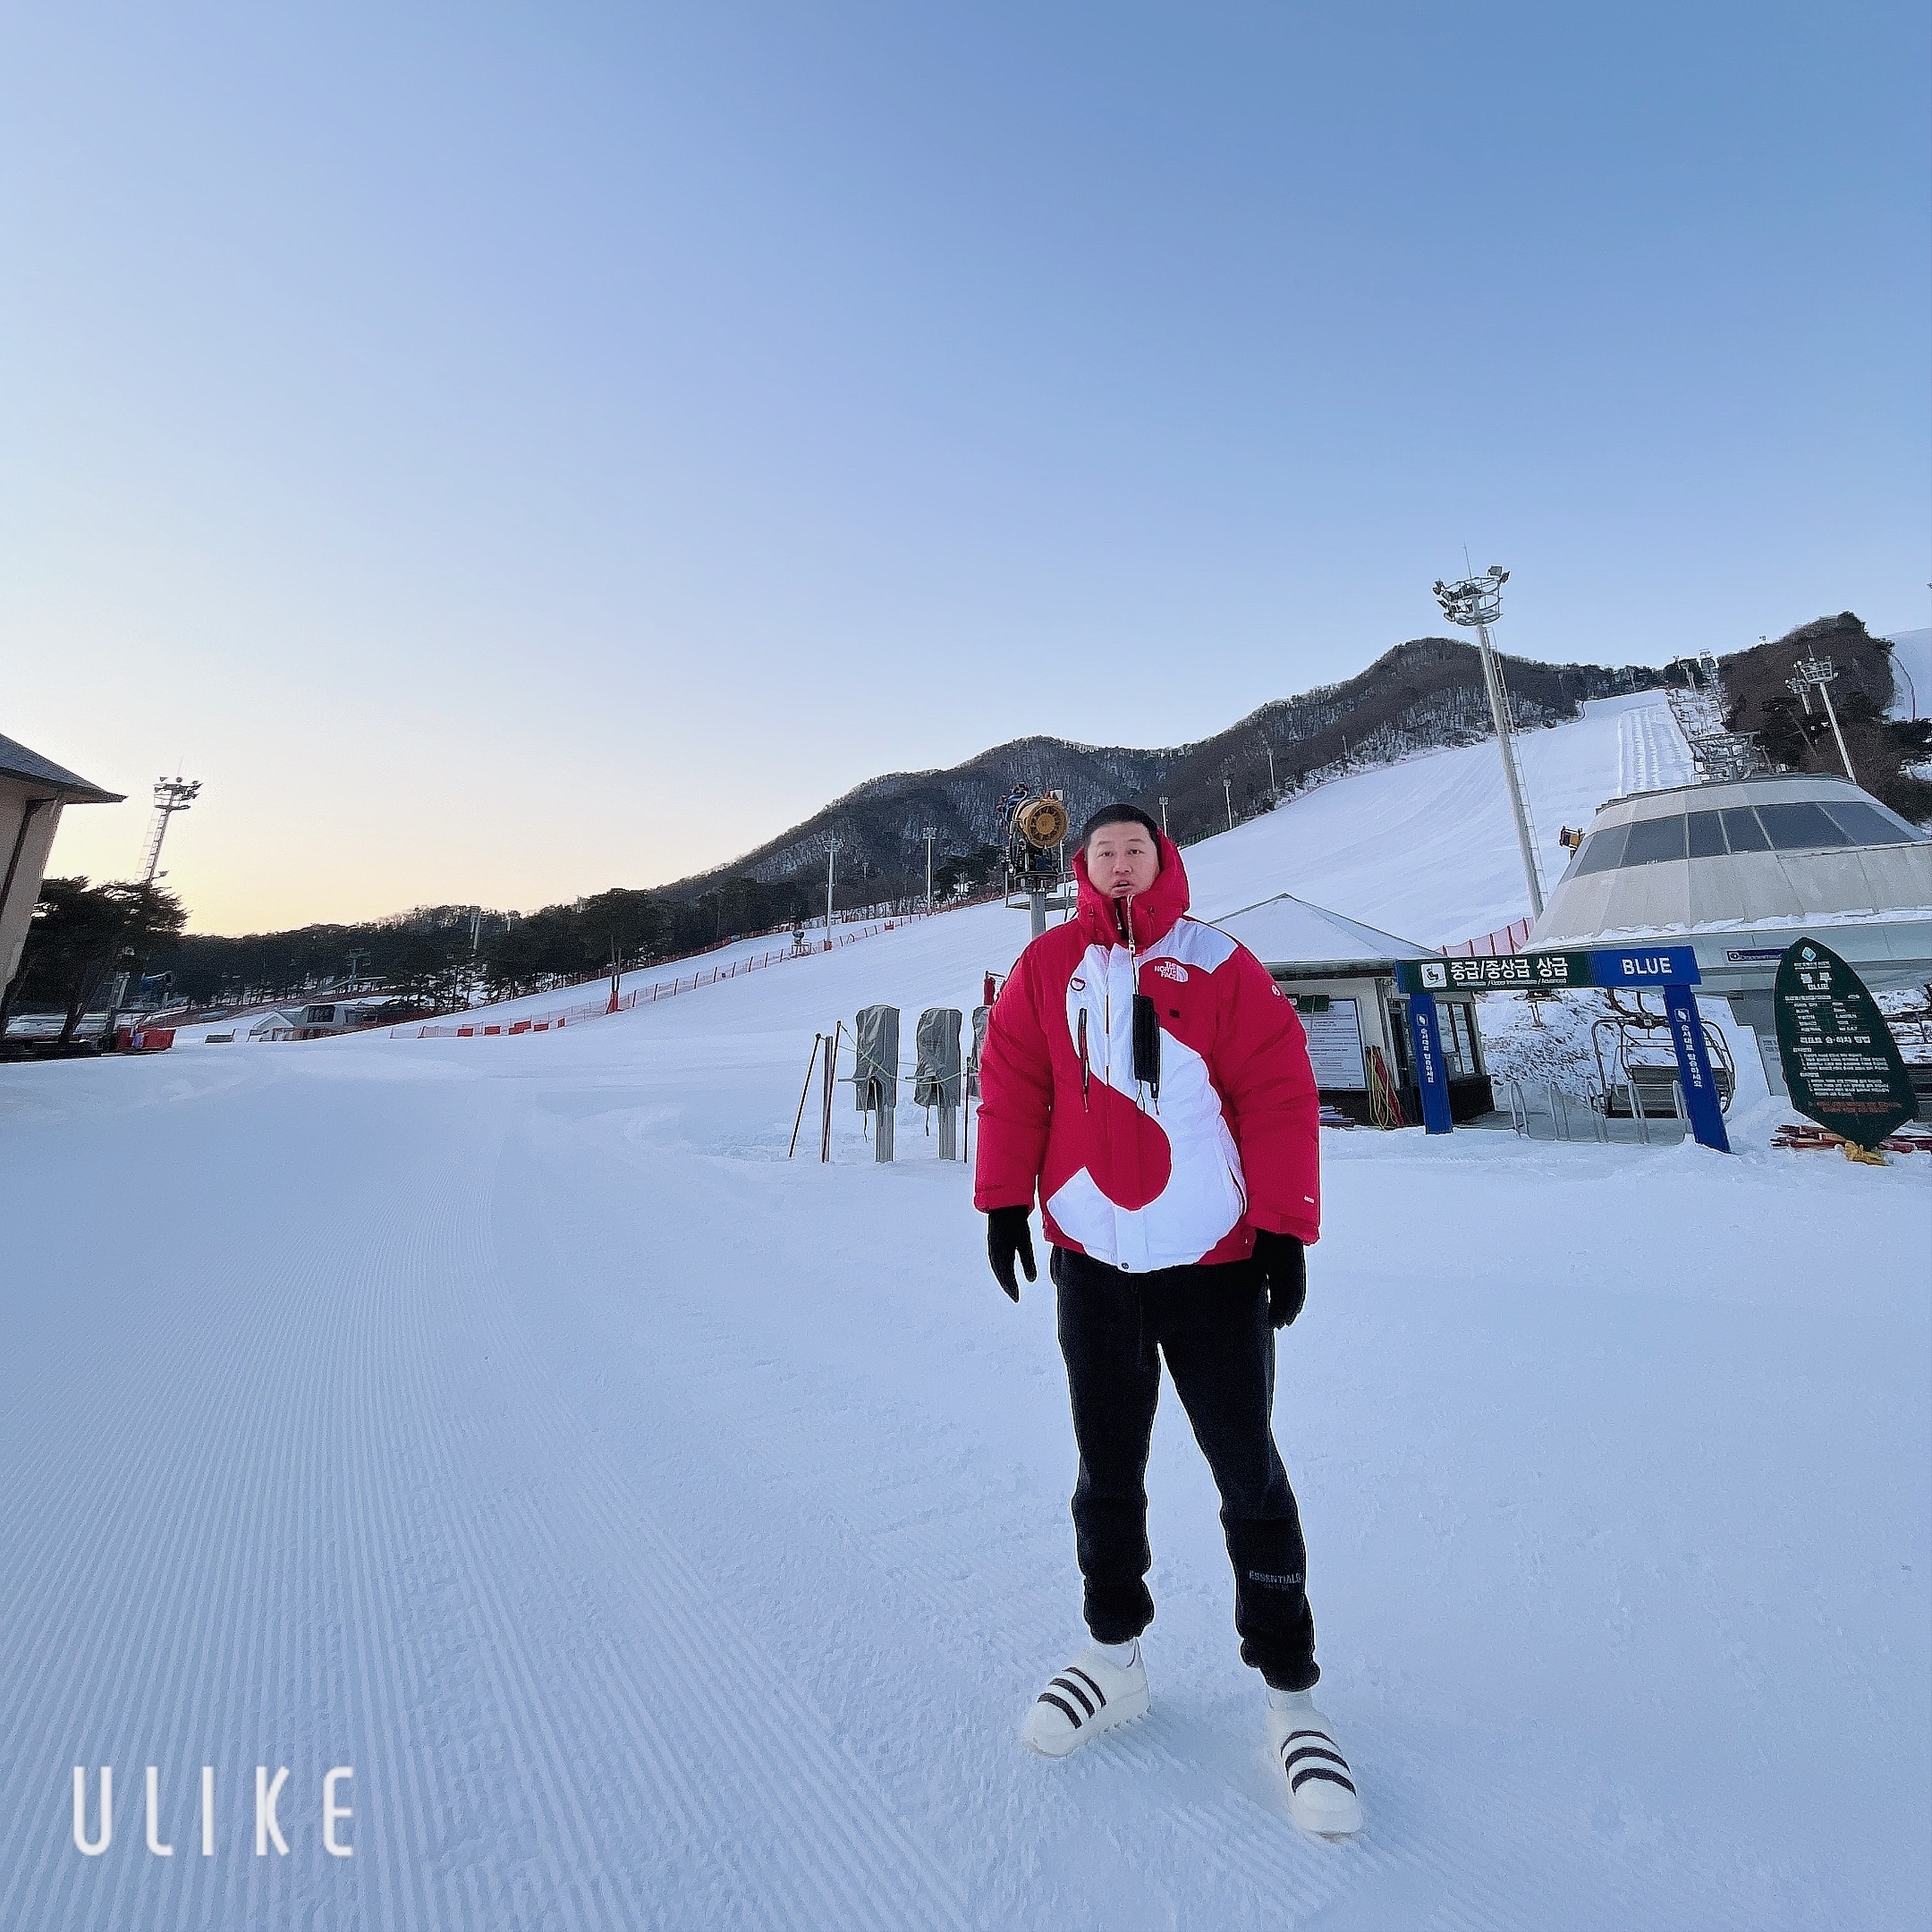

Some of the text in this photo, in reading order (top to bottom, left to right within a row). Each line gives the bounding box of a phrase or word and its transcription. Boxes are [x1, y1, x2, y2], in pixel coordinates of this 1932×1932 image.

[1450, 957, 1568, 980] 중급/중상급 상급
[1621, 956, 1673, 975] BLUE
[1249, 1571, 1303, 1584] ESSENTIALS
